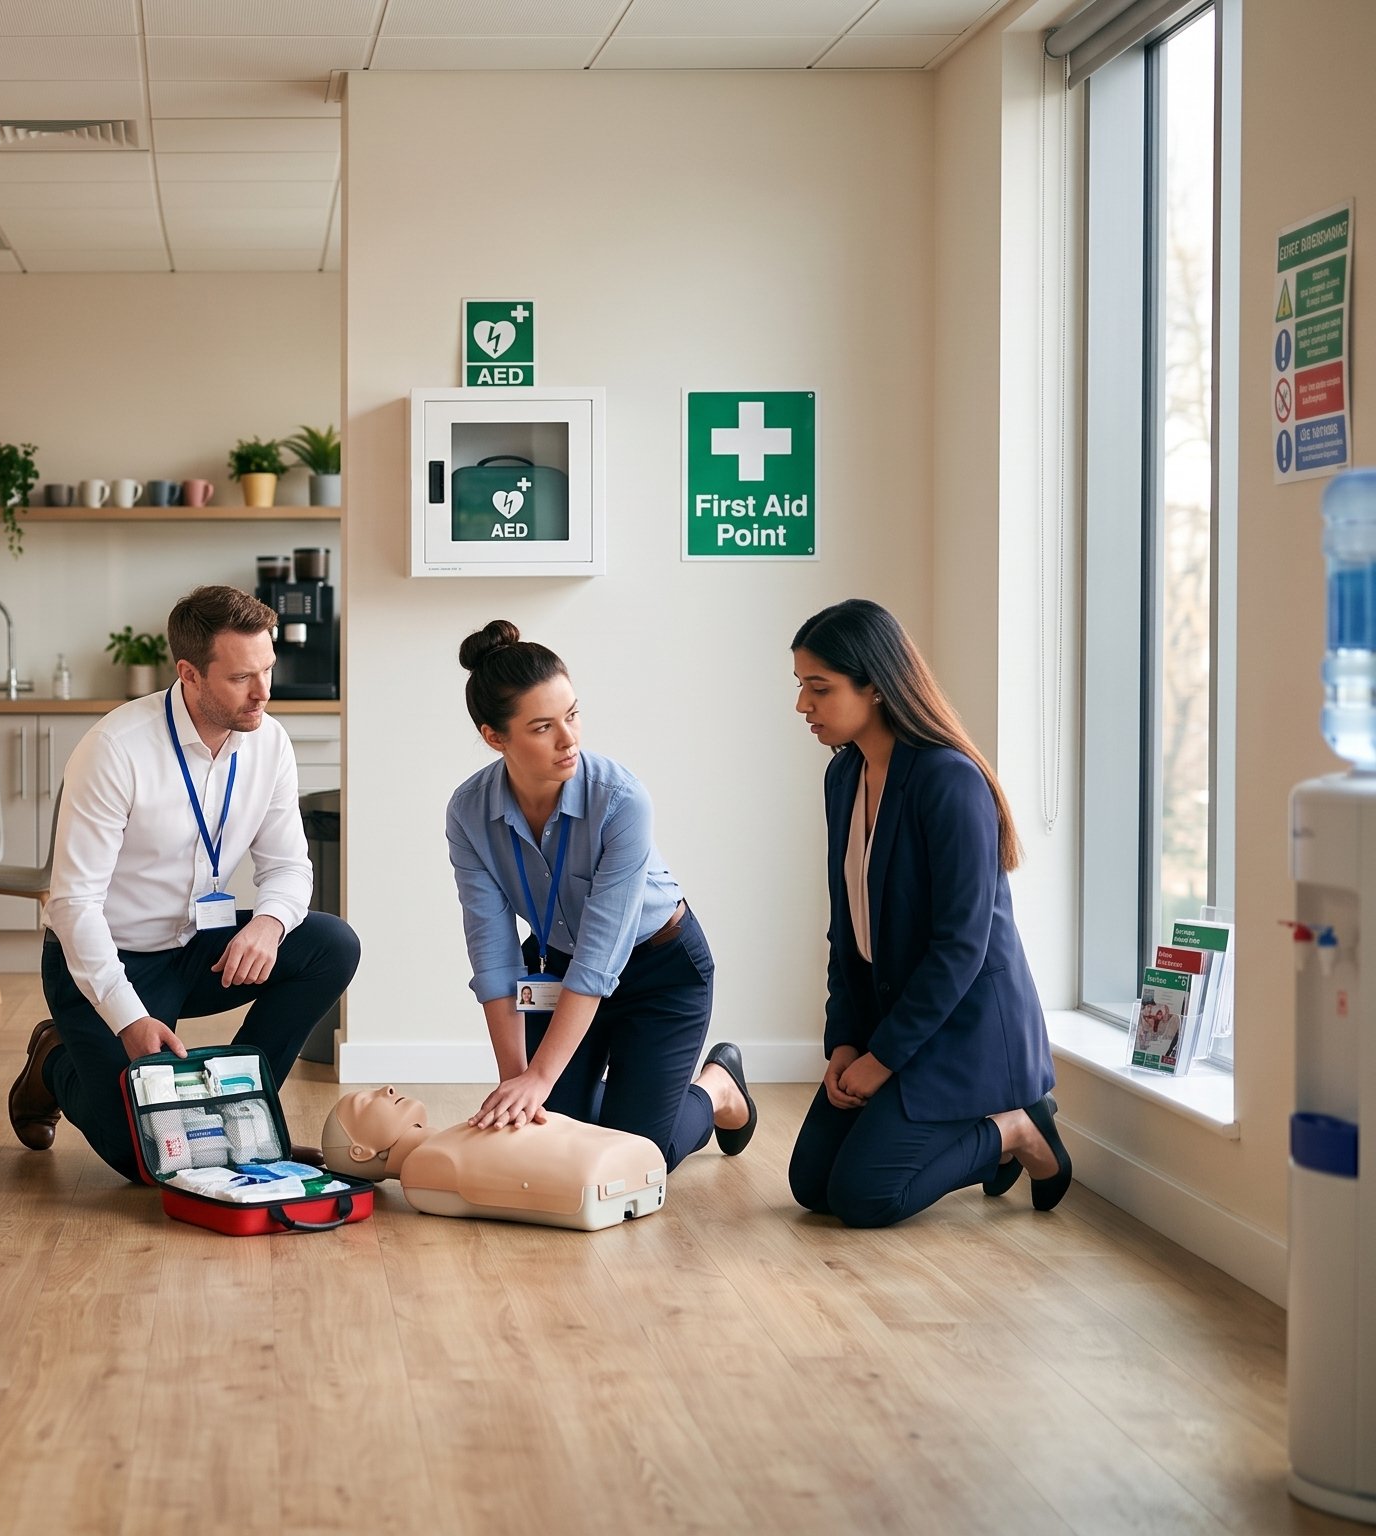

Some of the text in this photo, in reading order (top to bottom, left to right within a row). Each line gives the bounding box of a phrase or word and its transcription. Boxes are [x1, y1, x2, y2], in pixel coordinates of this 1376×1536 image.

[477, 367, 524, 385] AED
[695, 494, 808, 517] First Aid
[491, 523, 528, 538] AED
[717, 524, 787, 547] Point
